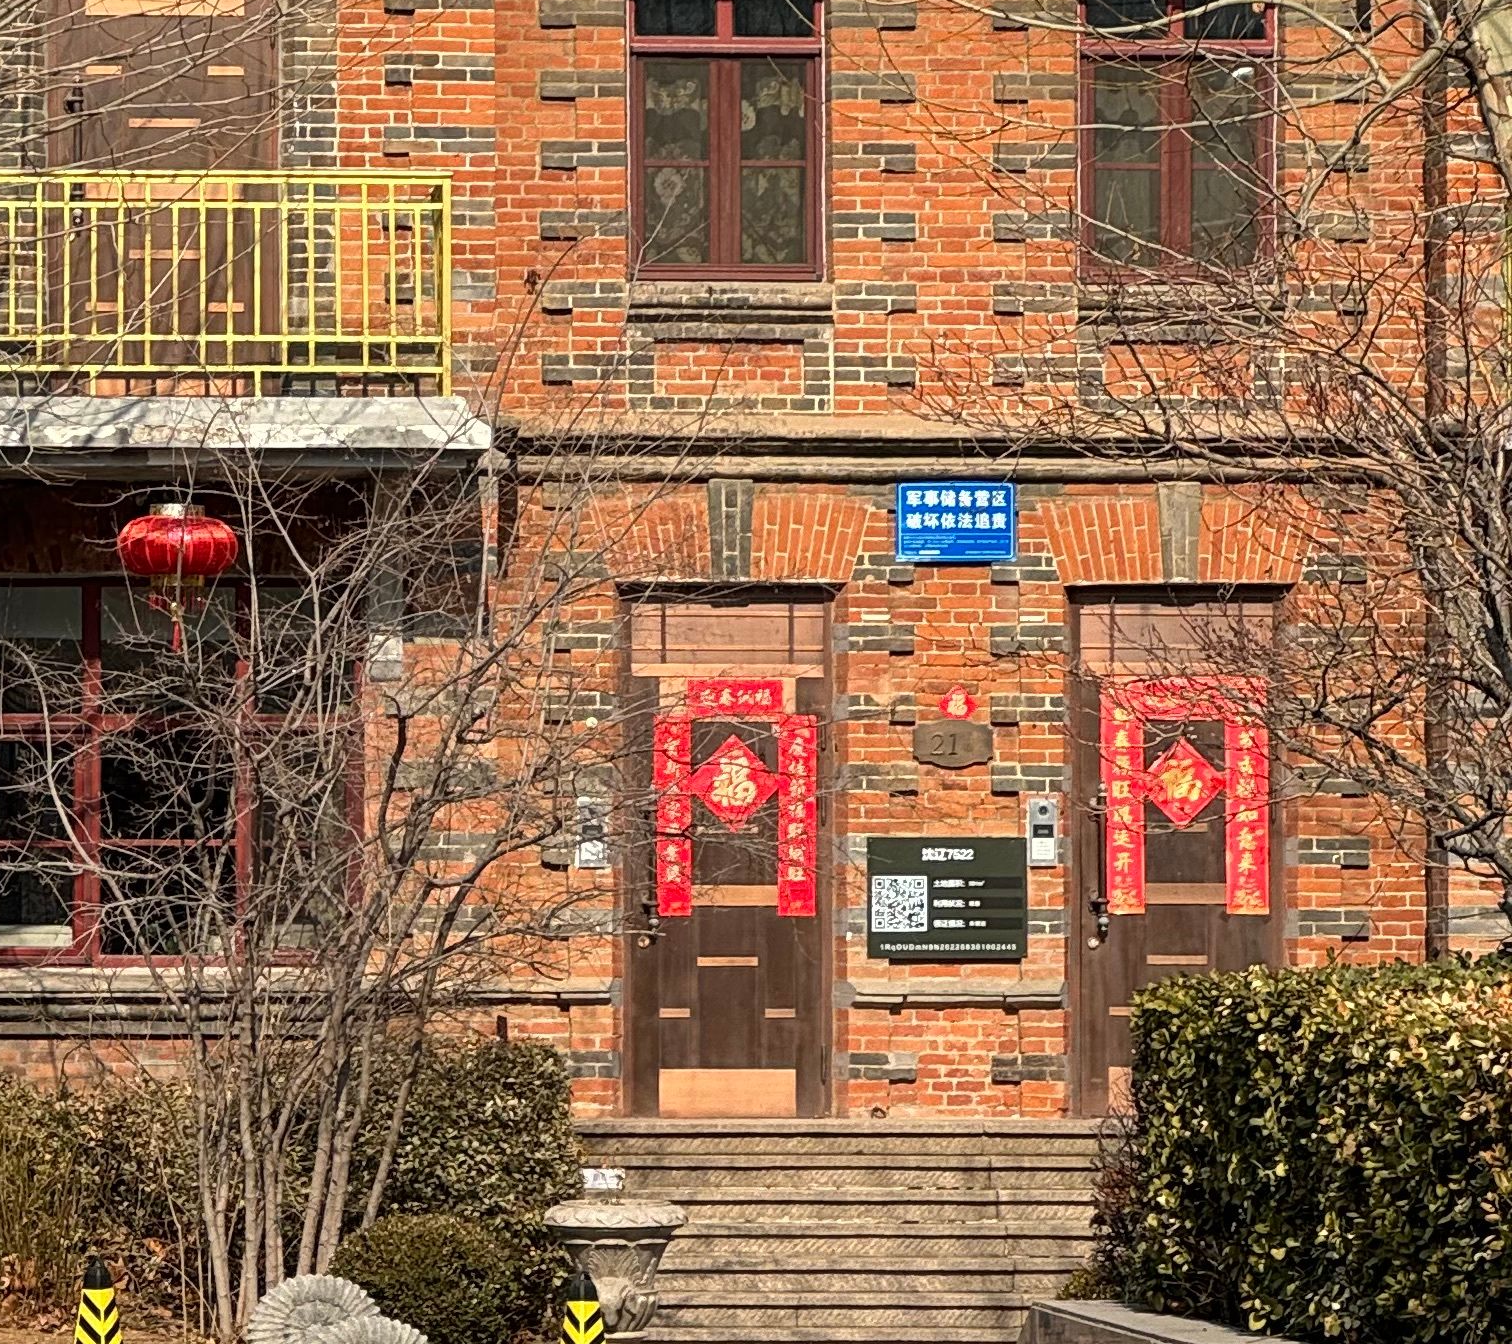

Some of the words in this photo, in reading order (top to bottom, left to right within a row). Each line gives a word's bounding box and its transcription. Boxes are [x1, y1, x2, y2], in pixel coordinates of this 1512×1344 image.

[906, 512, 1007, 529] 破坏依法追责
[930, 733, 958, 755] 21
[711, 751, 757, 807] 福
